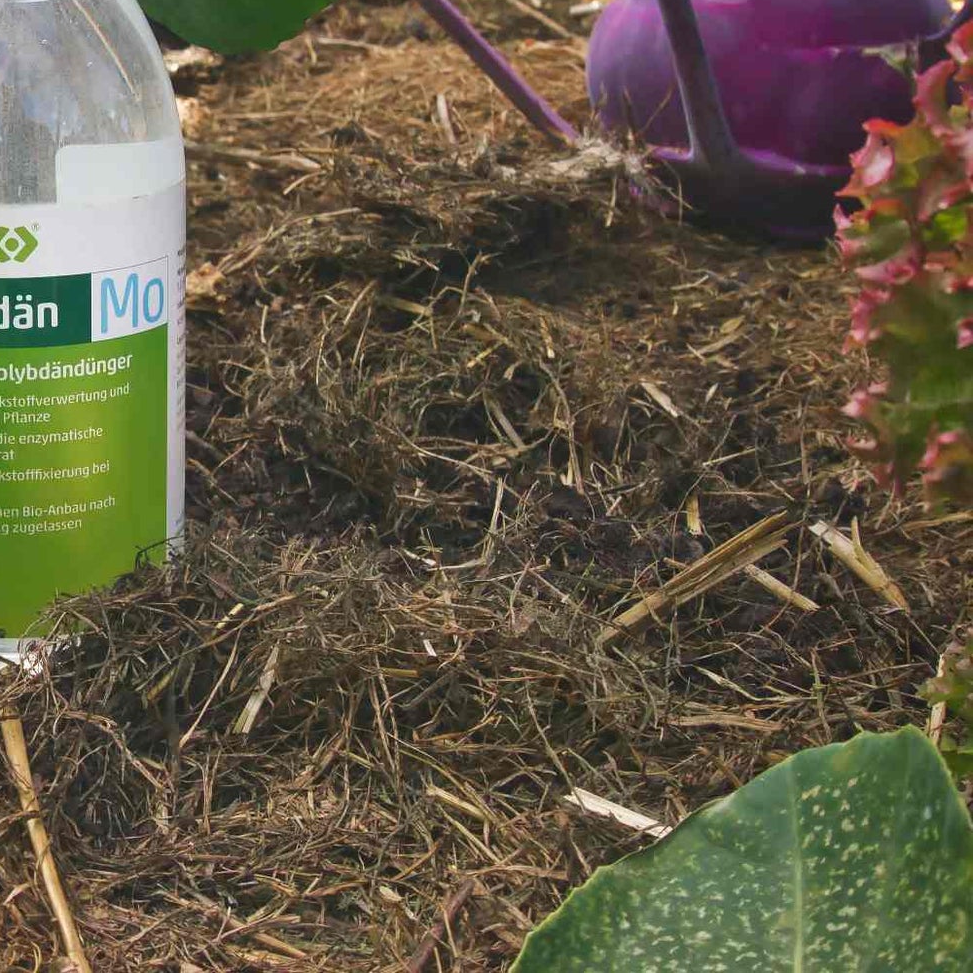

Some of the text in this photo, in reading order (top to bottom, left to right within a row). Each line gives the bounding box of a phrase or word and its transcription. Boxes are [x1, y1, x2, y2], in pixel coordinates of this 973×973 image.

[100, 273, 165, 334] Mo
[109, 381, 131, 398] und
[3, 411, 51, 424] Pflanze
[19, 427, 103, 446] enzymatische
[92, 460, 110, 474] bei
[22, 502, 87, 517] Bio-Anbau
[89, 495, 116, 510] nach
[12, 518, 82, 535] zugelassen
